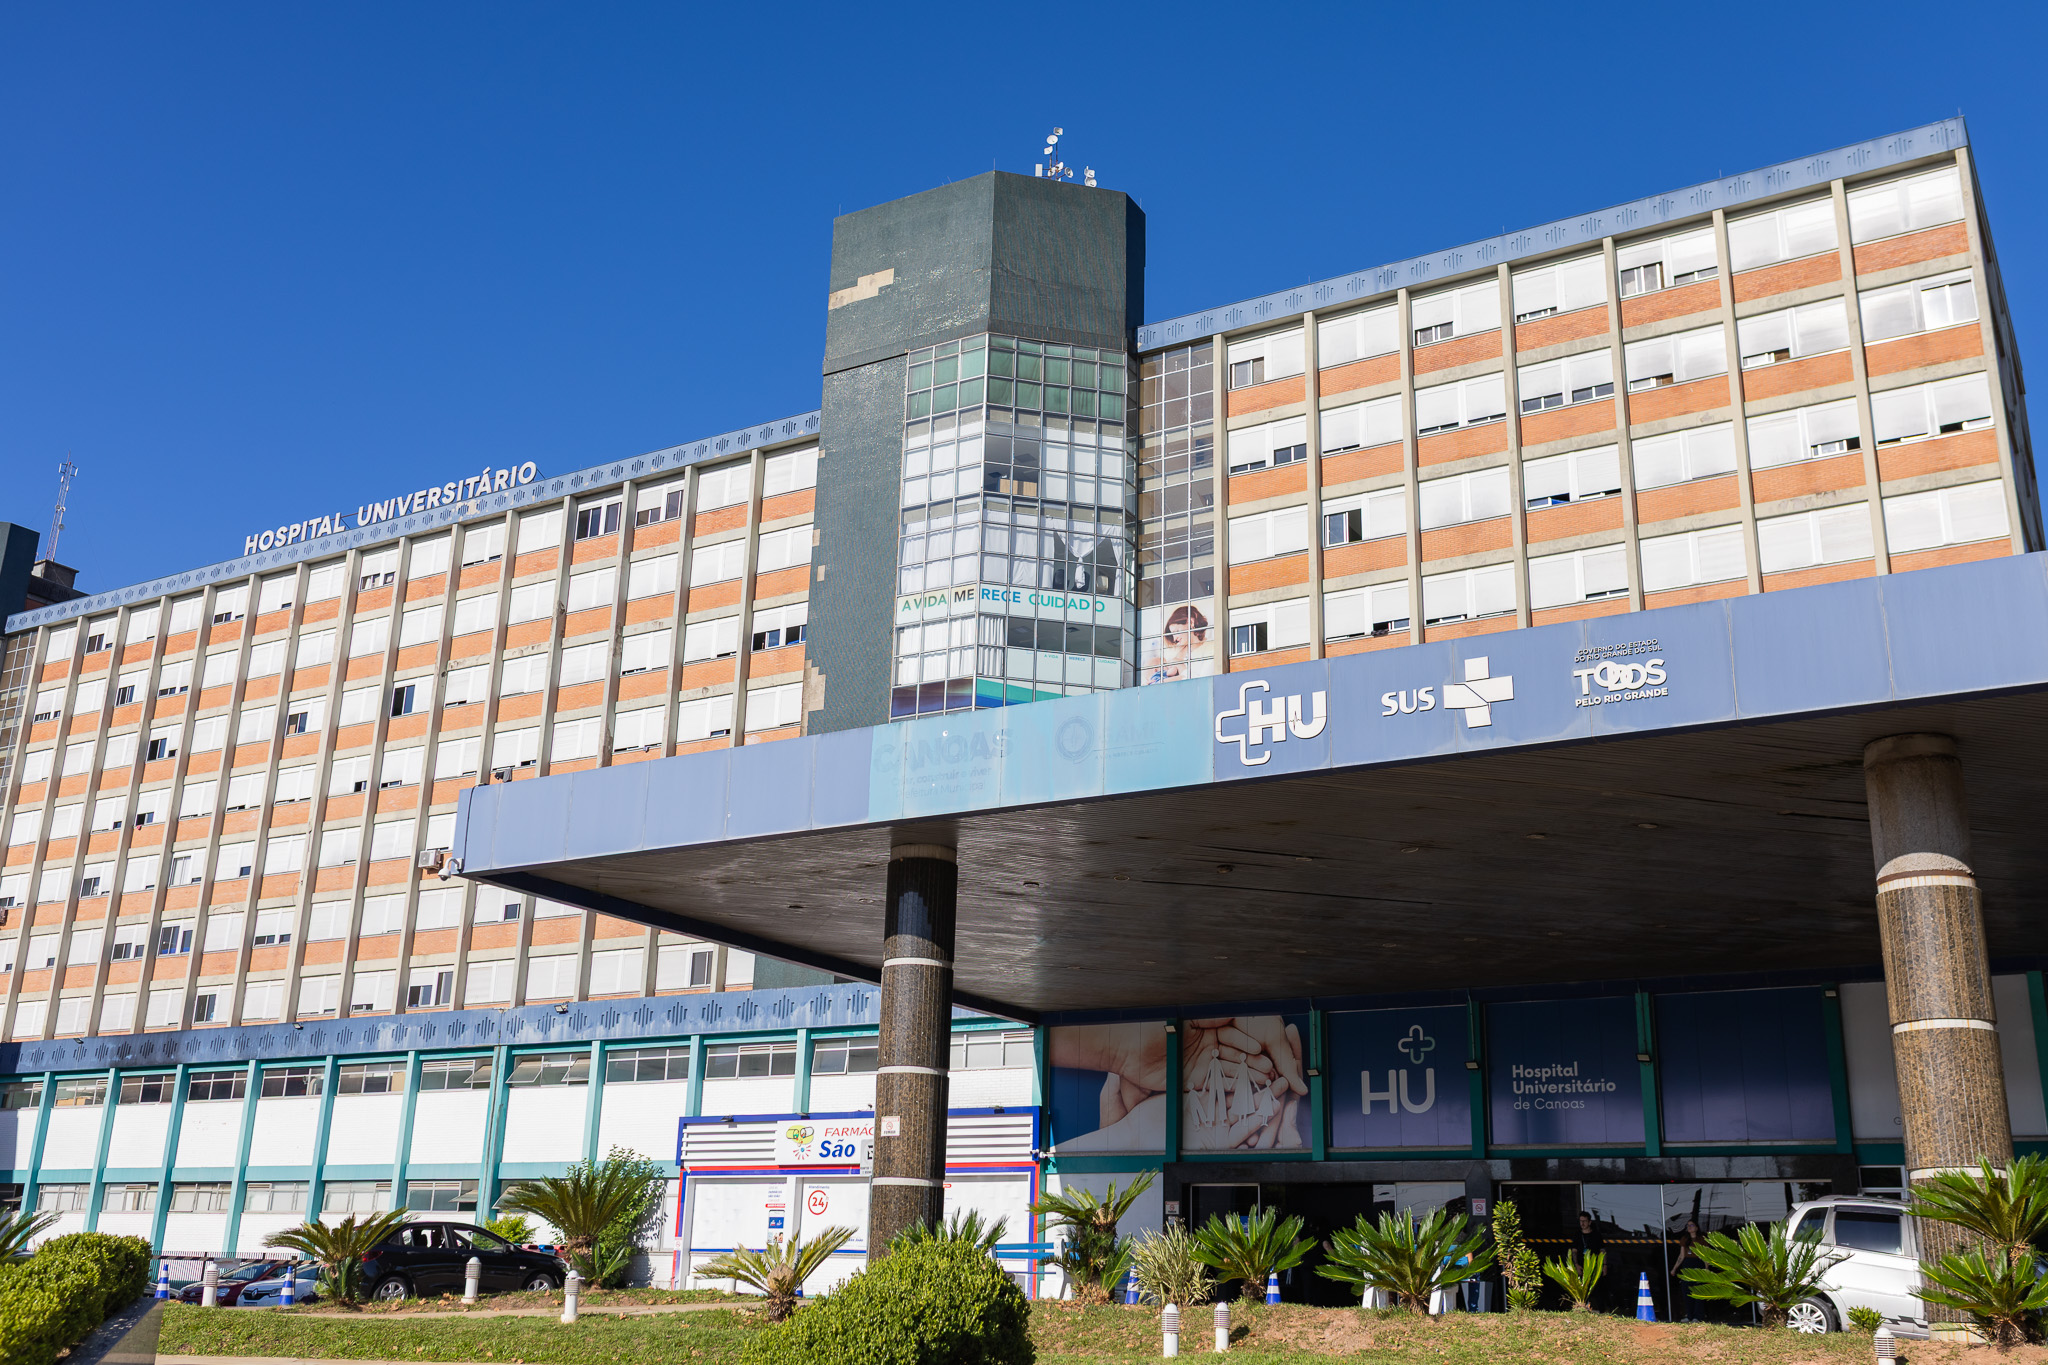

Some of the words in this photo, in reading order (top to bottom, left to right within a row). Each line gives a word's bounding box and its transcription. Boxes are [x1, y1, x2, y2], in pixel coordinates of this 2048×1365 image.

[244, 512, 346, 556] HOSPITAL
[356, 461, 538, 527] UNIVERSITÁRIO
[902, 600, 911, 612] A
[913, 593, 947, 610] VIDA
[1029, 593, 1105, 613] CUIDADO
[1574, 655, 1586, 663] DO
[1586, 653, 1600, 661] RIO
[1602, 648, 1633, 660] GRANDE
[1635, 646, 1646, 654] DO
[1577, 644, 1614, 656] GOVERNO
[1628, 638, 1658, 649] ESTADO
[1573, 658, 1667, 696] TODOS
[1381, 686, 1437, 717] SUS
[1575, 696, 1602, 708] PELO
[1604, 693, 1622, 704] RIO
[1624, 687, 1669, 701] GRANDE
[1248, 690, 1328, 746] HU
[873, 728, 1014, 773] CANOAS
[896, 786, 939, 799] Pefeitura
[940, 781, 986, 794] Muniipal
[1512, 1061, 1579, 1082] Hospital
[1361, 1067, 1436, 1115] HU
[1512, 1077, 1616, 1095] Universitário
[1513, 1098, 1530, 1110] de
[1534, 1098, 1585, 1110] Canoas
[819, 1139, 855, 1158] São
[812, 1196, 825, 1208] 24
